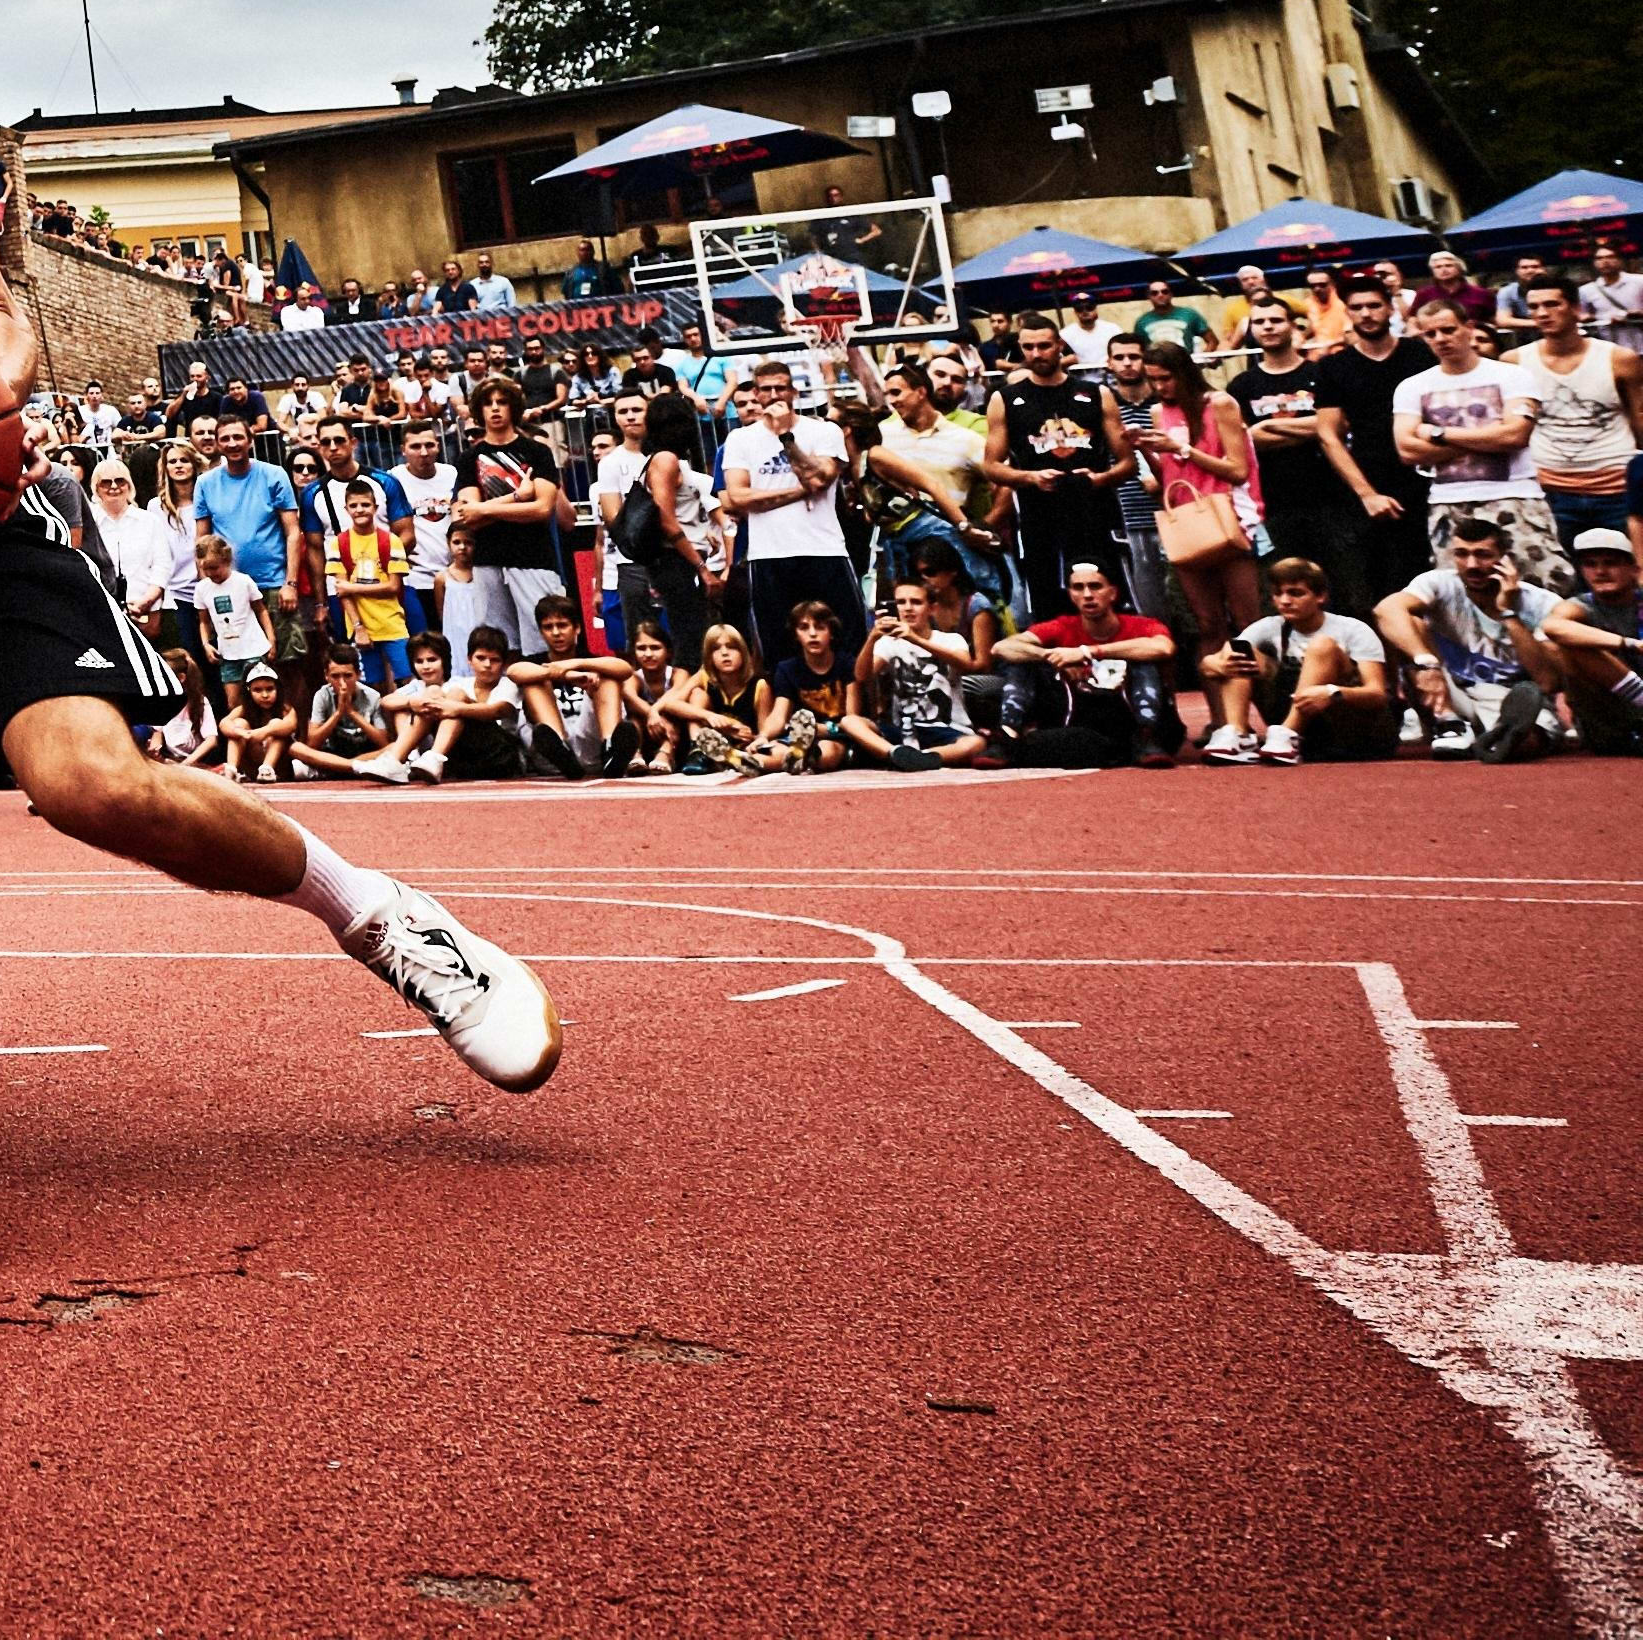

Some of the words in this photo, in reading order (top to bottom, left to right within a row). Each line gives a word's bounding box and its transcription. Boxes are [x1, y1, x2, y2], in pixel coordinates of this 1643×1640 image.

[384, 325, 453, 351] TEAR
[462, 317, 513, 342] THE
[518, 305, 615, 337] COURT
[621, 300, 664, 327] UP
